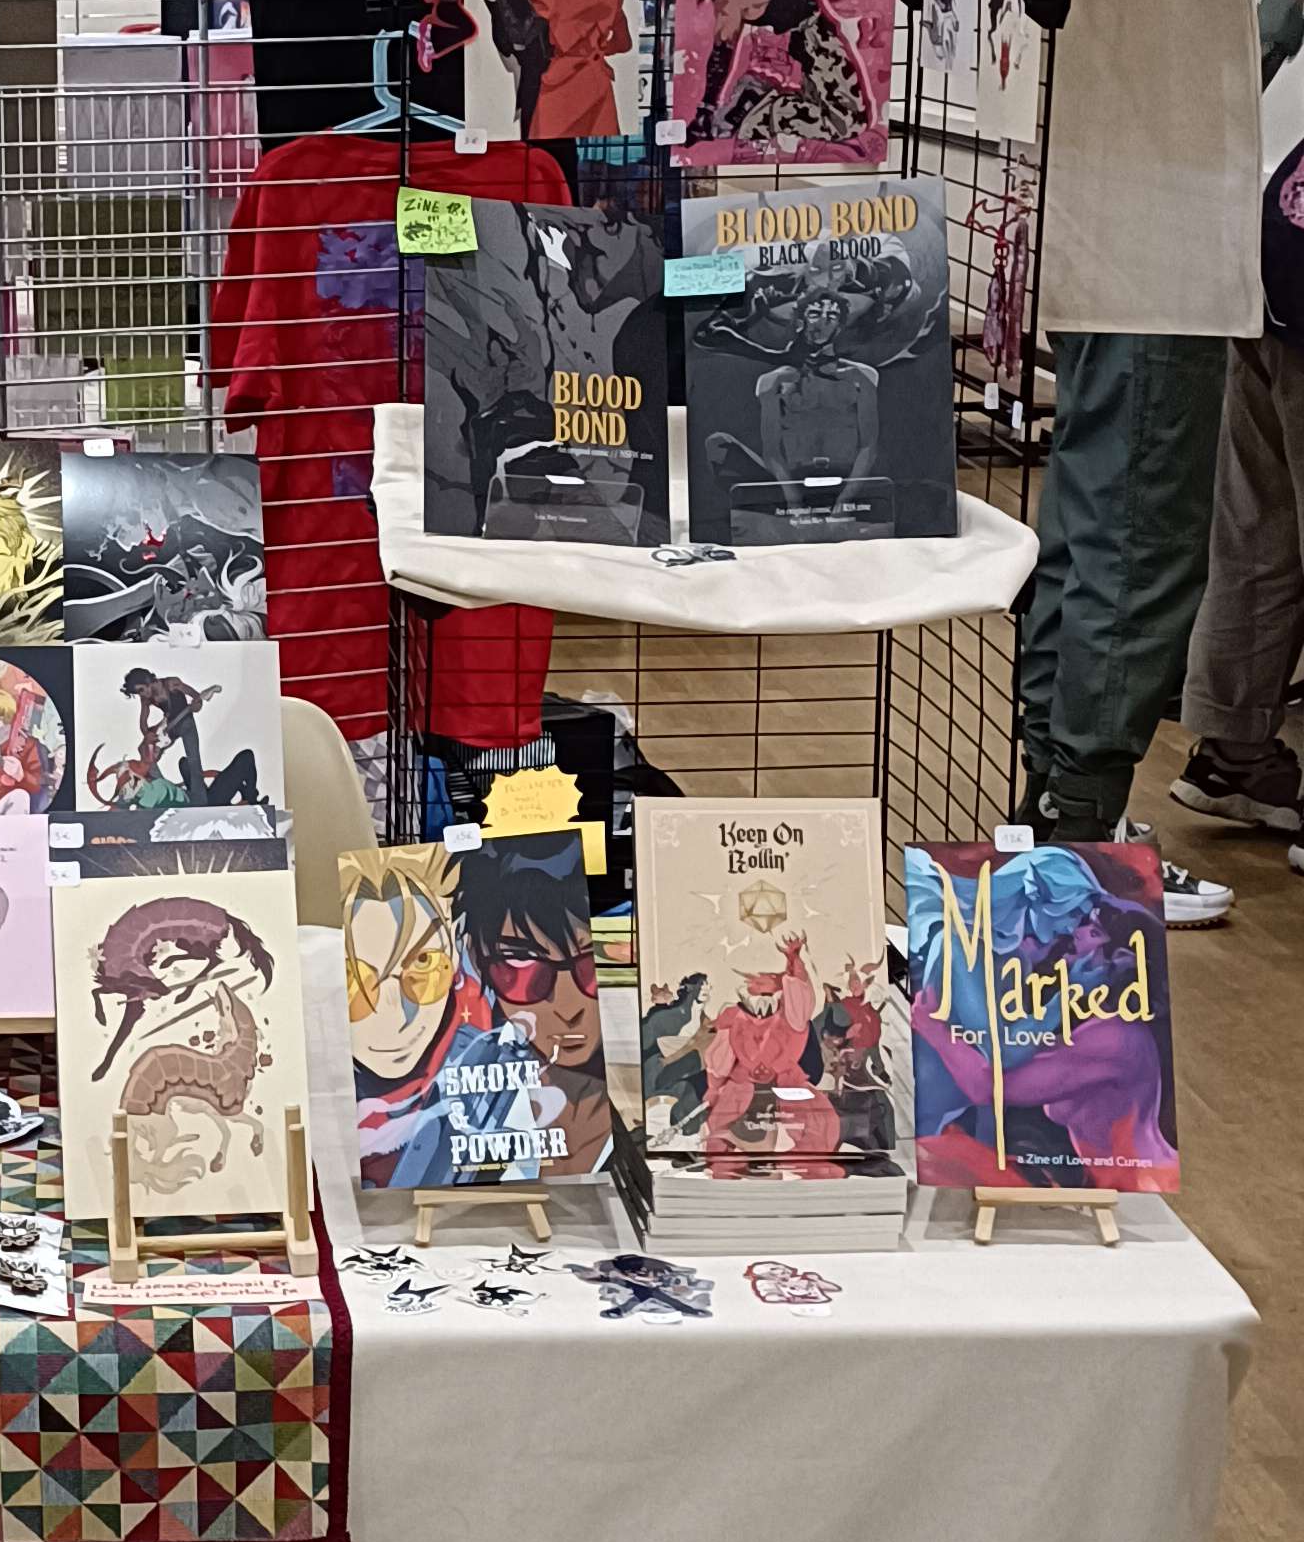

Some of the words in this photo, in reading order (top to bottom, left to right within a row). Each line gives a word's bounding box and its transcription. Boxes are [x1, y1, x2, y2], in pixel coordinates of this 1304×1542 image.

[716, 203, 822, 247] BLOOD
[830, 194, 918, 237] BOND
[759, 241, 808, 267] BLACK
[829, 236, 882, 261] BLOOD
[554, 370, 642, 410] BLOOD
[554, 408, 627, 446] BOND
[773, 821, 804, 847] On
[929, 860, 1155, 1171] Marked
[950, 1025, 985, 1045] For
[1004, 1026, 1056, 1046] Love
[446, 1060, 542, 1096] SMOKE
[448, 1100, 469, 1131] &
[450, 1127, 569, 1165] POWDER
[1026, 1154, 1050, 1164] Zine
[1052, 1154, 1064, 1164] of
[1066, 1154, 1092, 1166] Love
[1093, 1156, 1114, 1166] and
